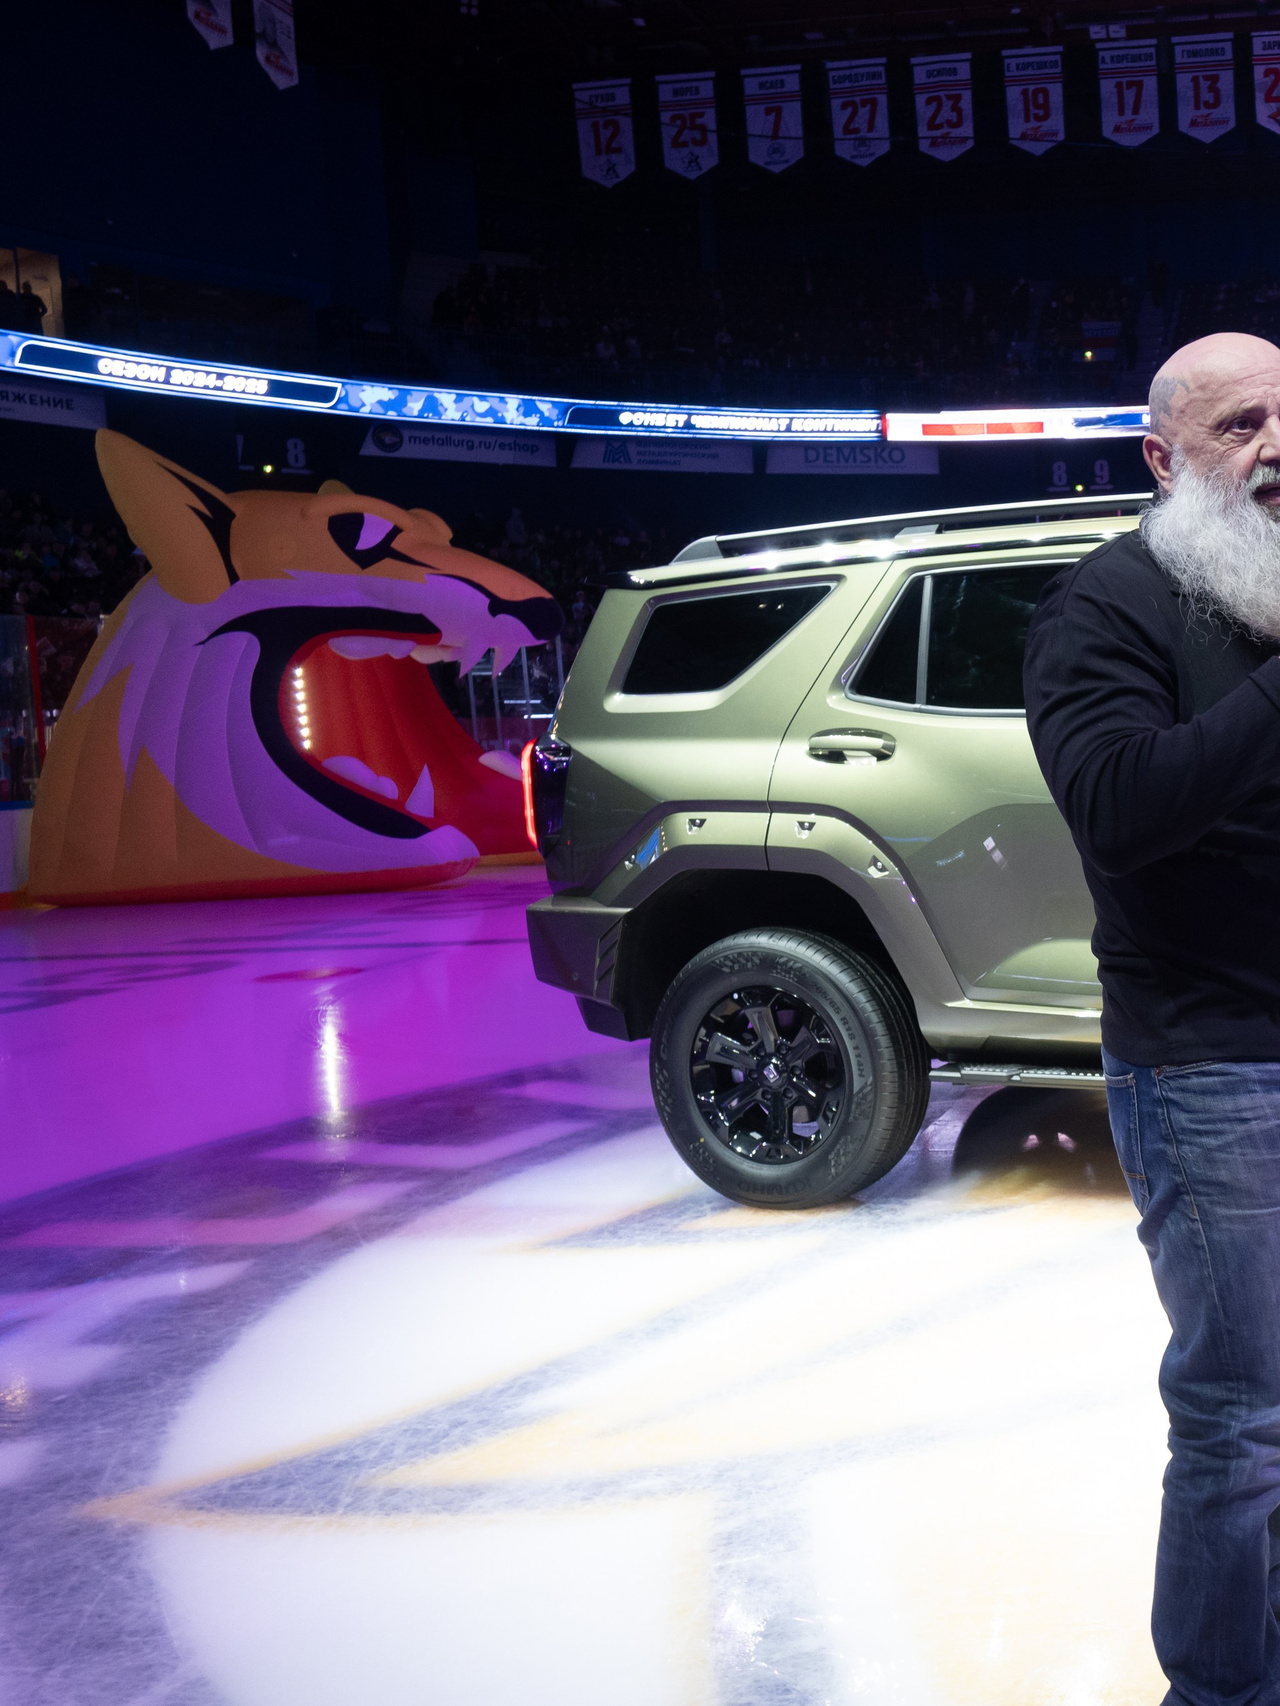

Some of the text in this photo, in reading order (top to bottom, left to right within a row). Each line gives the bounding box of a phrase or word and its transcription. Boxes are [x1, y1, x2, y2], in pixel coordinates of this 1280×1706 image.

[1110, 52, 1154, 64] КОРЕШКОВ
[1181, 47, 1226, 58] ГОМОЛЯКО
[832, 71, 883, 85] БОРОДУЛИН
[926, 67, 958, 78] ОСИПОВ
[1006, 60, 1059, 72] Е. КОРЕШКОВ
[673, 86, 699, 97] МОРЕВ
[759, 79, 785, 91] ИСАЕВ
[1190, 74, 1221, 110] 13
[1020, 87, 1050, 123] 19
[1114, 80, 1143, 116] 17
[764, 106, 782, 140] 7
[840, 97, 877, 135] 27
[925, 93, 963, 131] 23
[592, 119, 622, 155] 12
[670, 112, 707, 148] 25
[97, 358, 268, 394] СЕЗОН 2024-2025
[287, 437, 306, 467] 8
[408, 434, 540, 455] metallurg.ru/eshop
[804, 446, 905, 464] DEMSKO
[1052, 461, 1068, 486] 8
[1094, 459, 1110, 484] 9
